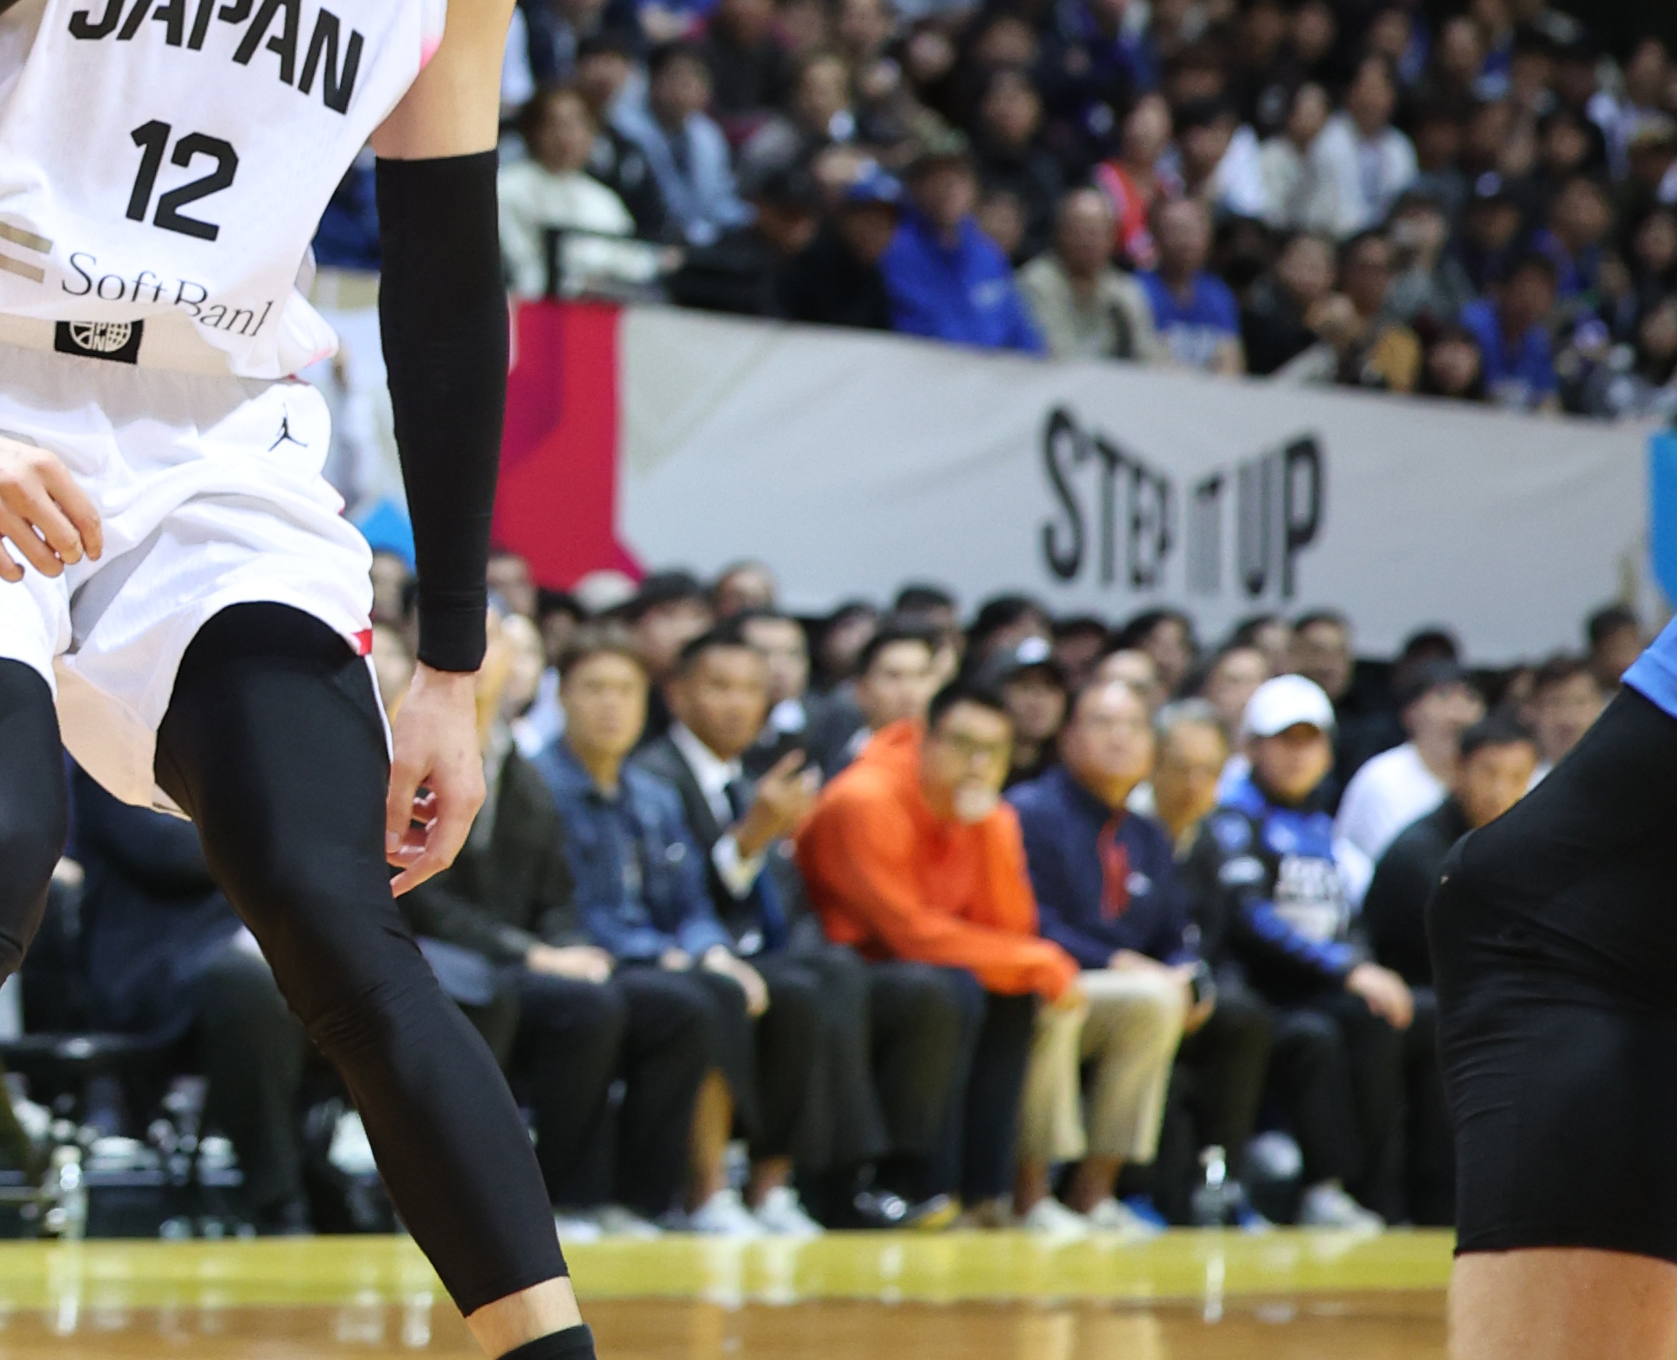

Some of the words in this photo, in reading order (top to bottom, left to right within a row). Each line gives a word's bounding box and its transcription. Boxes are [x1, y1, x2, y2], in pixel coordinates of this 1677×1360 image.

[125, 119, 239, 242] 12
[1042, 404, 1171, 588] STEP
[1238, 436, 1322, 598] UP
